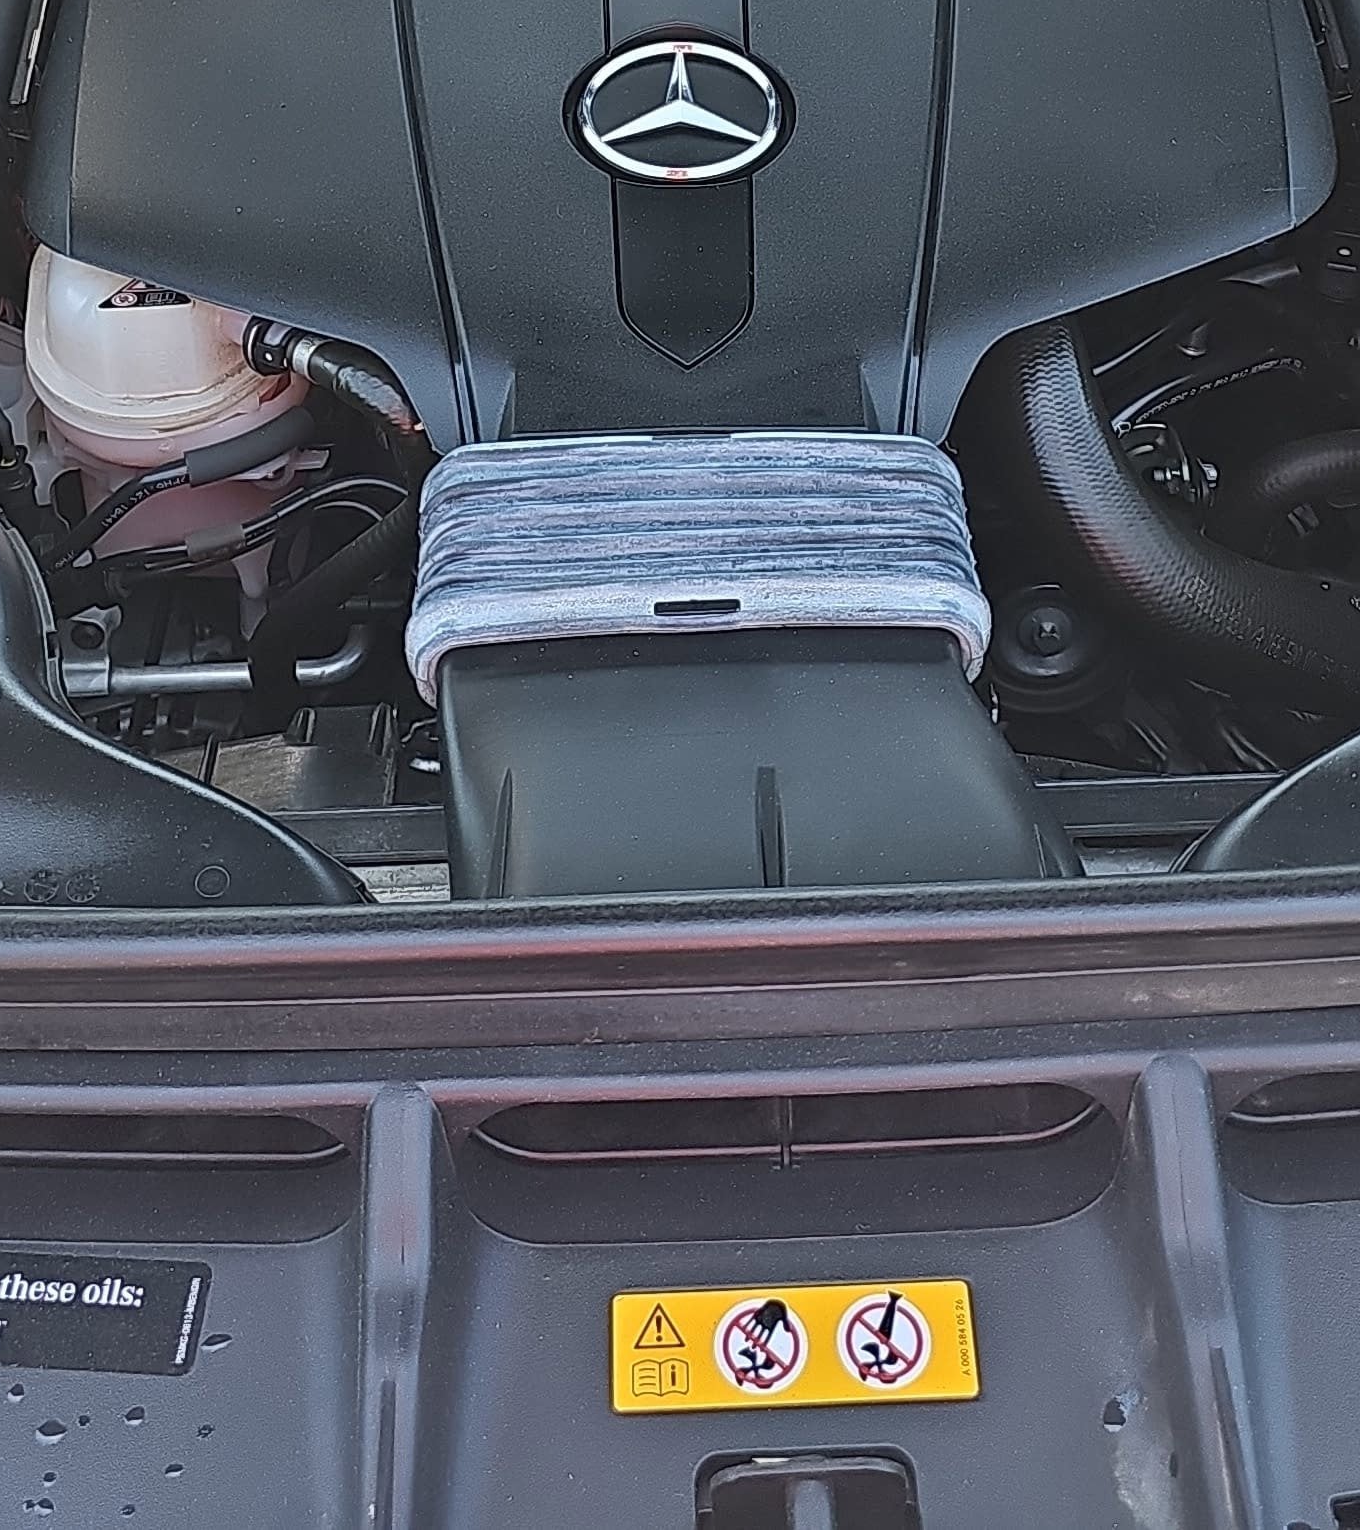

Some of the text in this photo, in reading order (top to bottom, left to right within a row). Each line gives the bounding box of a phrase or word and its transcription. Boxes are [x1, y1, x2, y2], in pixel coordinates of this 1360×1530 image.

[82, 1277, 145, 1307] oils:
[954, 1299, 970, 1376] A 000 584 05 26
